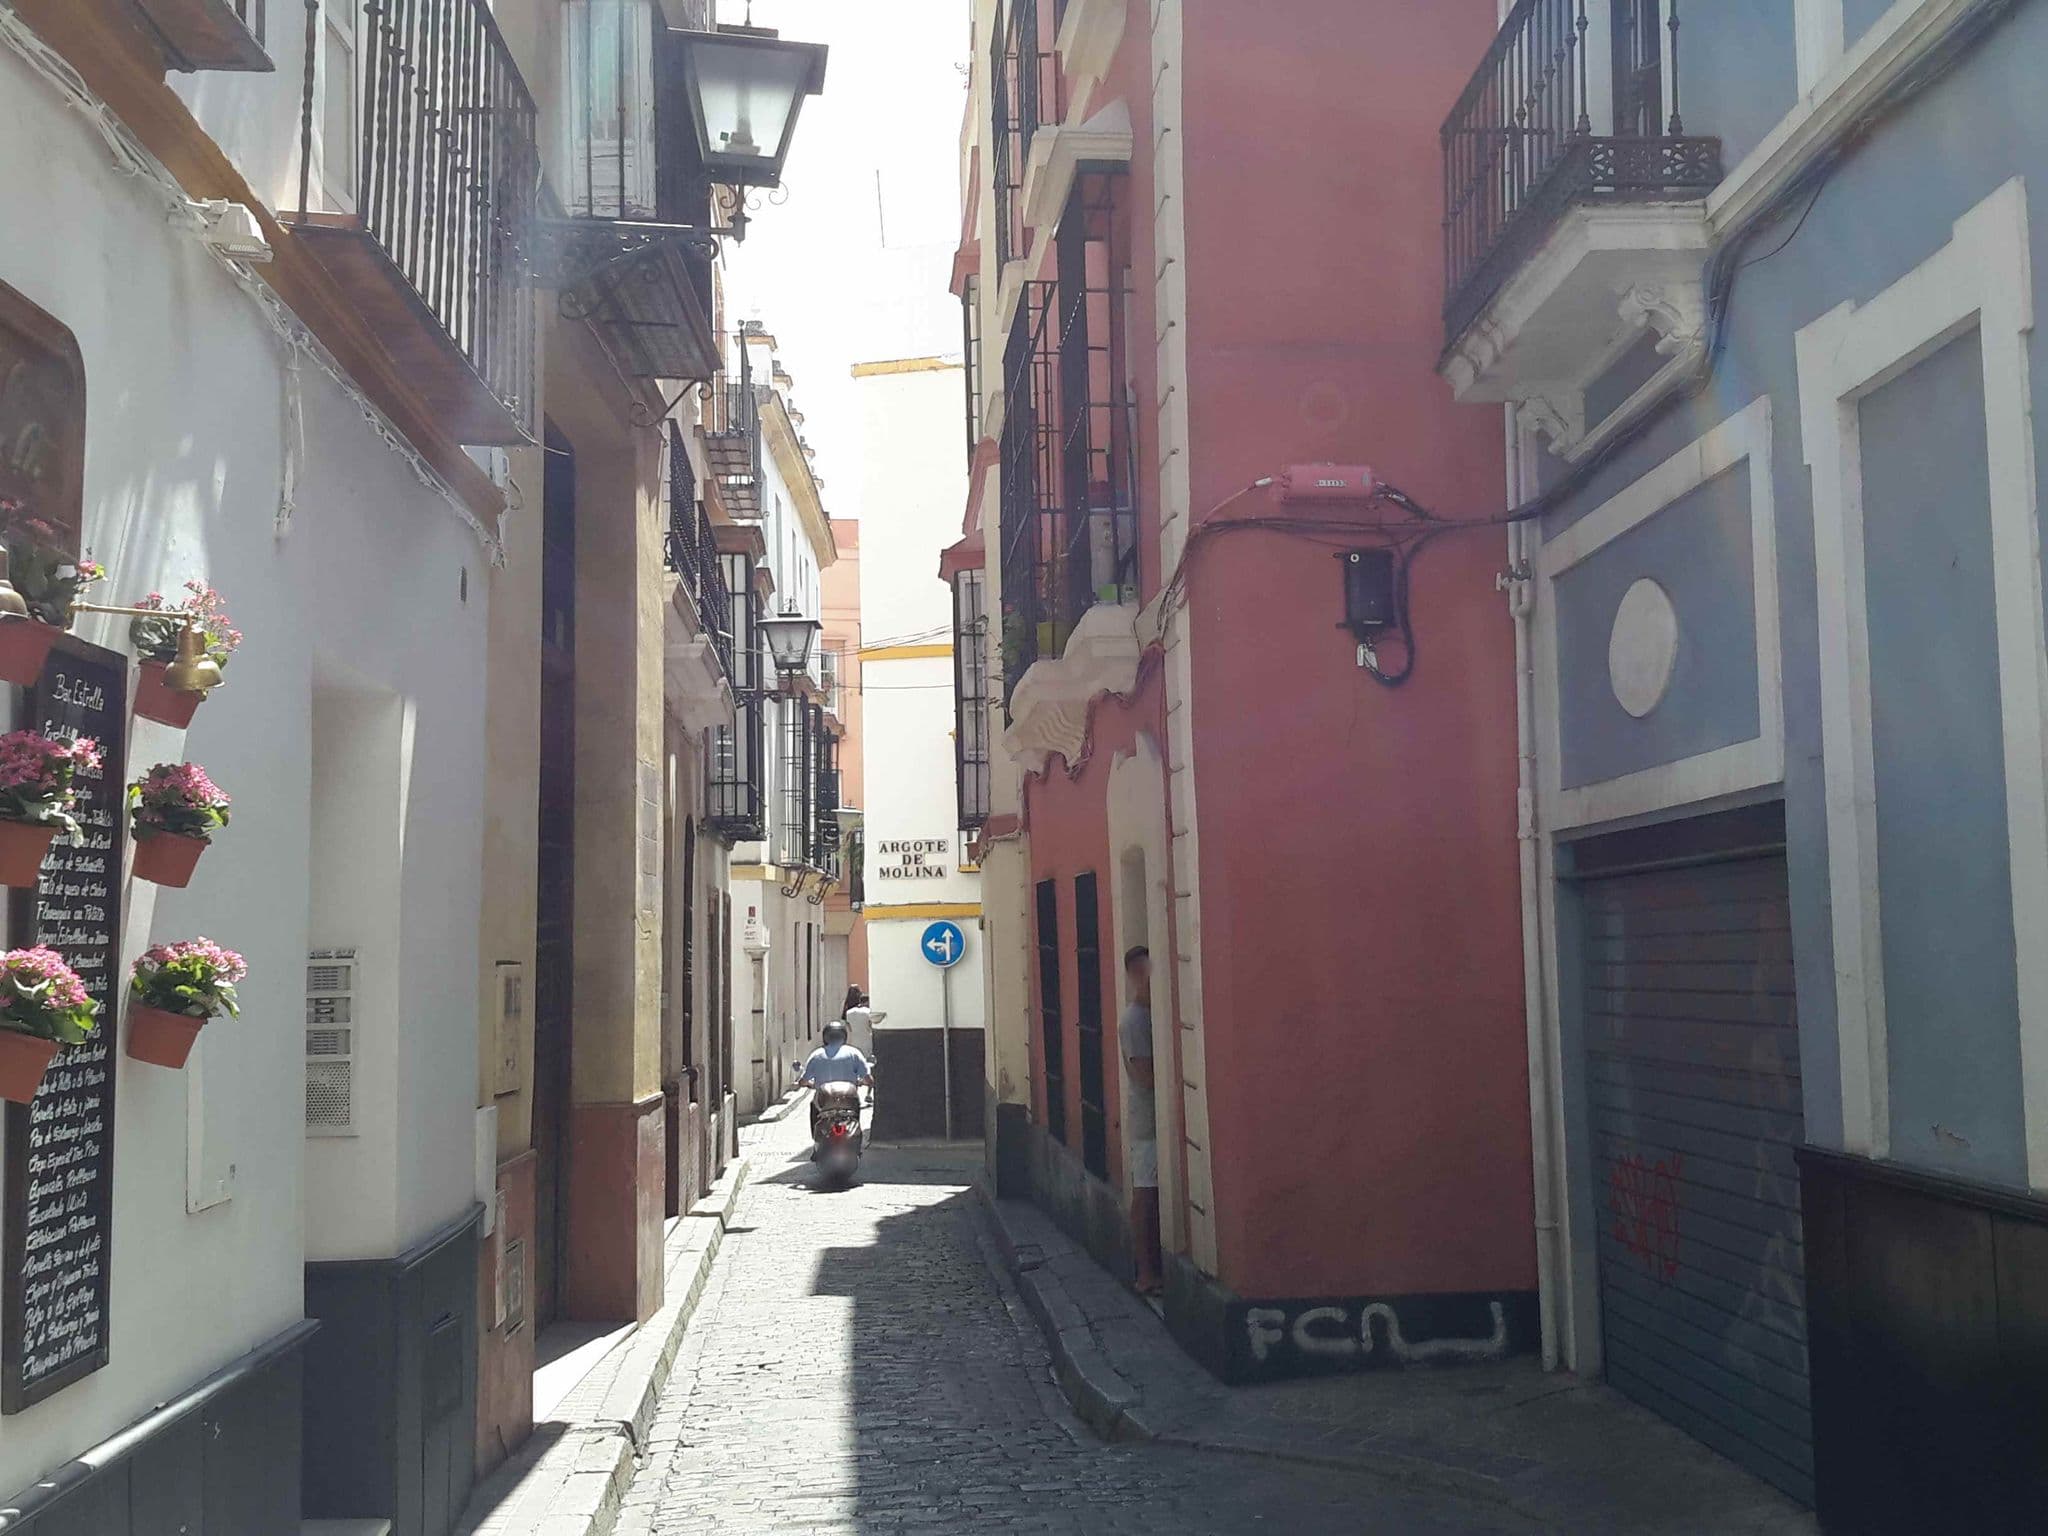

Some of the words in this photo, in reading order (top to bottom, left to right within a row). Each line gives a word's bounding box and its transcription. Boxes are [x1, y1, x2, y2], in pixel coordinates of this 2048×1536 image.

[52, 673, 72, 702] Bar
[73, 679, 104, 711] Estrella
[879, 840, 947, 854] ARGOTE
[902, 854, 923, 865] DE
[879, 866, 944, 878] MOLINA
